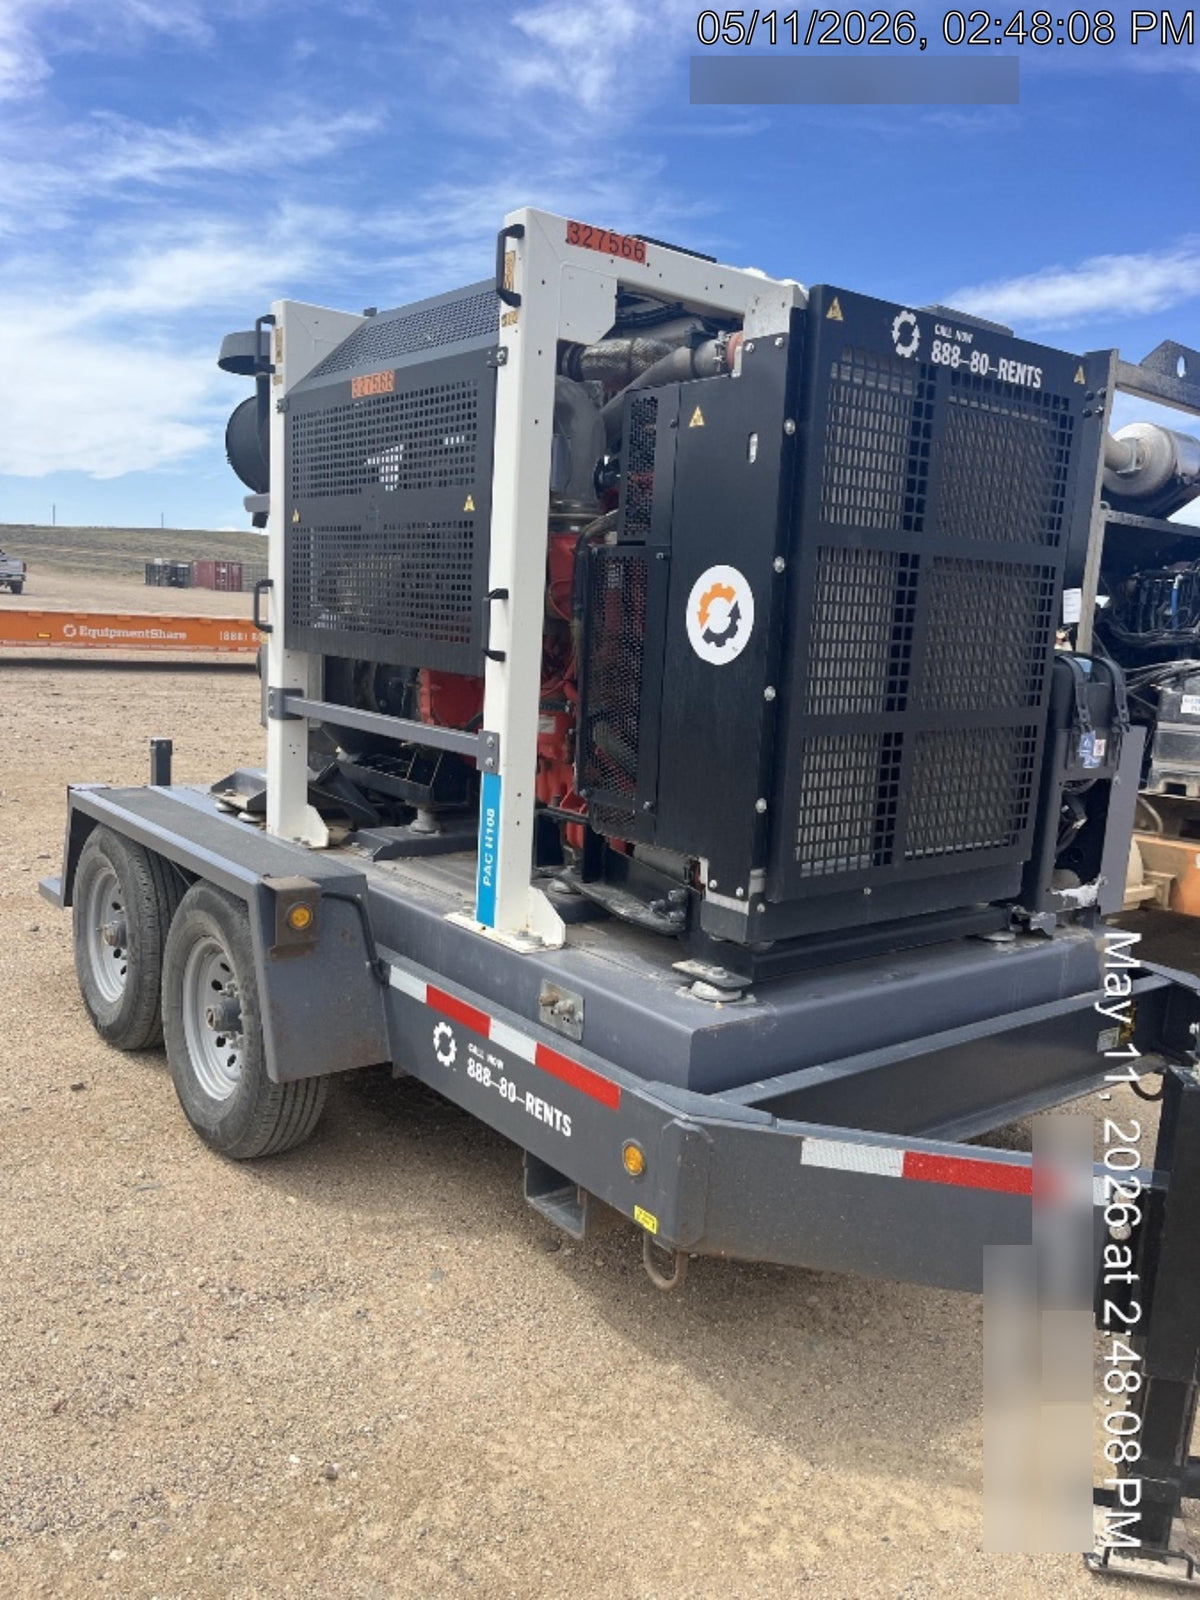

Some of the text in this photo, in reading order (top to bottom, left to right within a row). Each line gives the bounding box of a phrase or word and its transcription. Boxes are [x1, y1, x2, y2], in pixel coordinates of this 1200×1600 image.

[568, 221, 646, 262] 327566
[931, 339, 1043, 389] 888-80-RENTS
[79, 625, 187, 640] EquipmentShare
[483, 852, 494, 887] PAC
[467, 1057, 571, 1137] 888-80-RENTS
